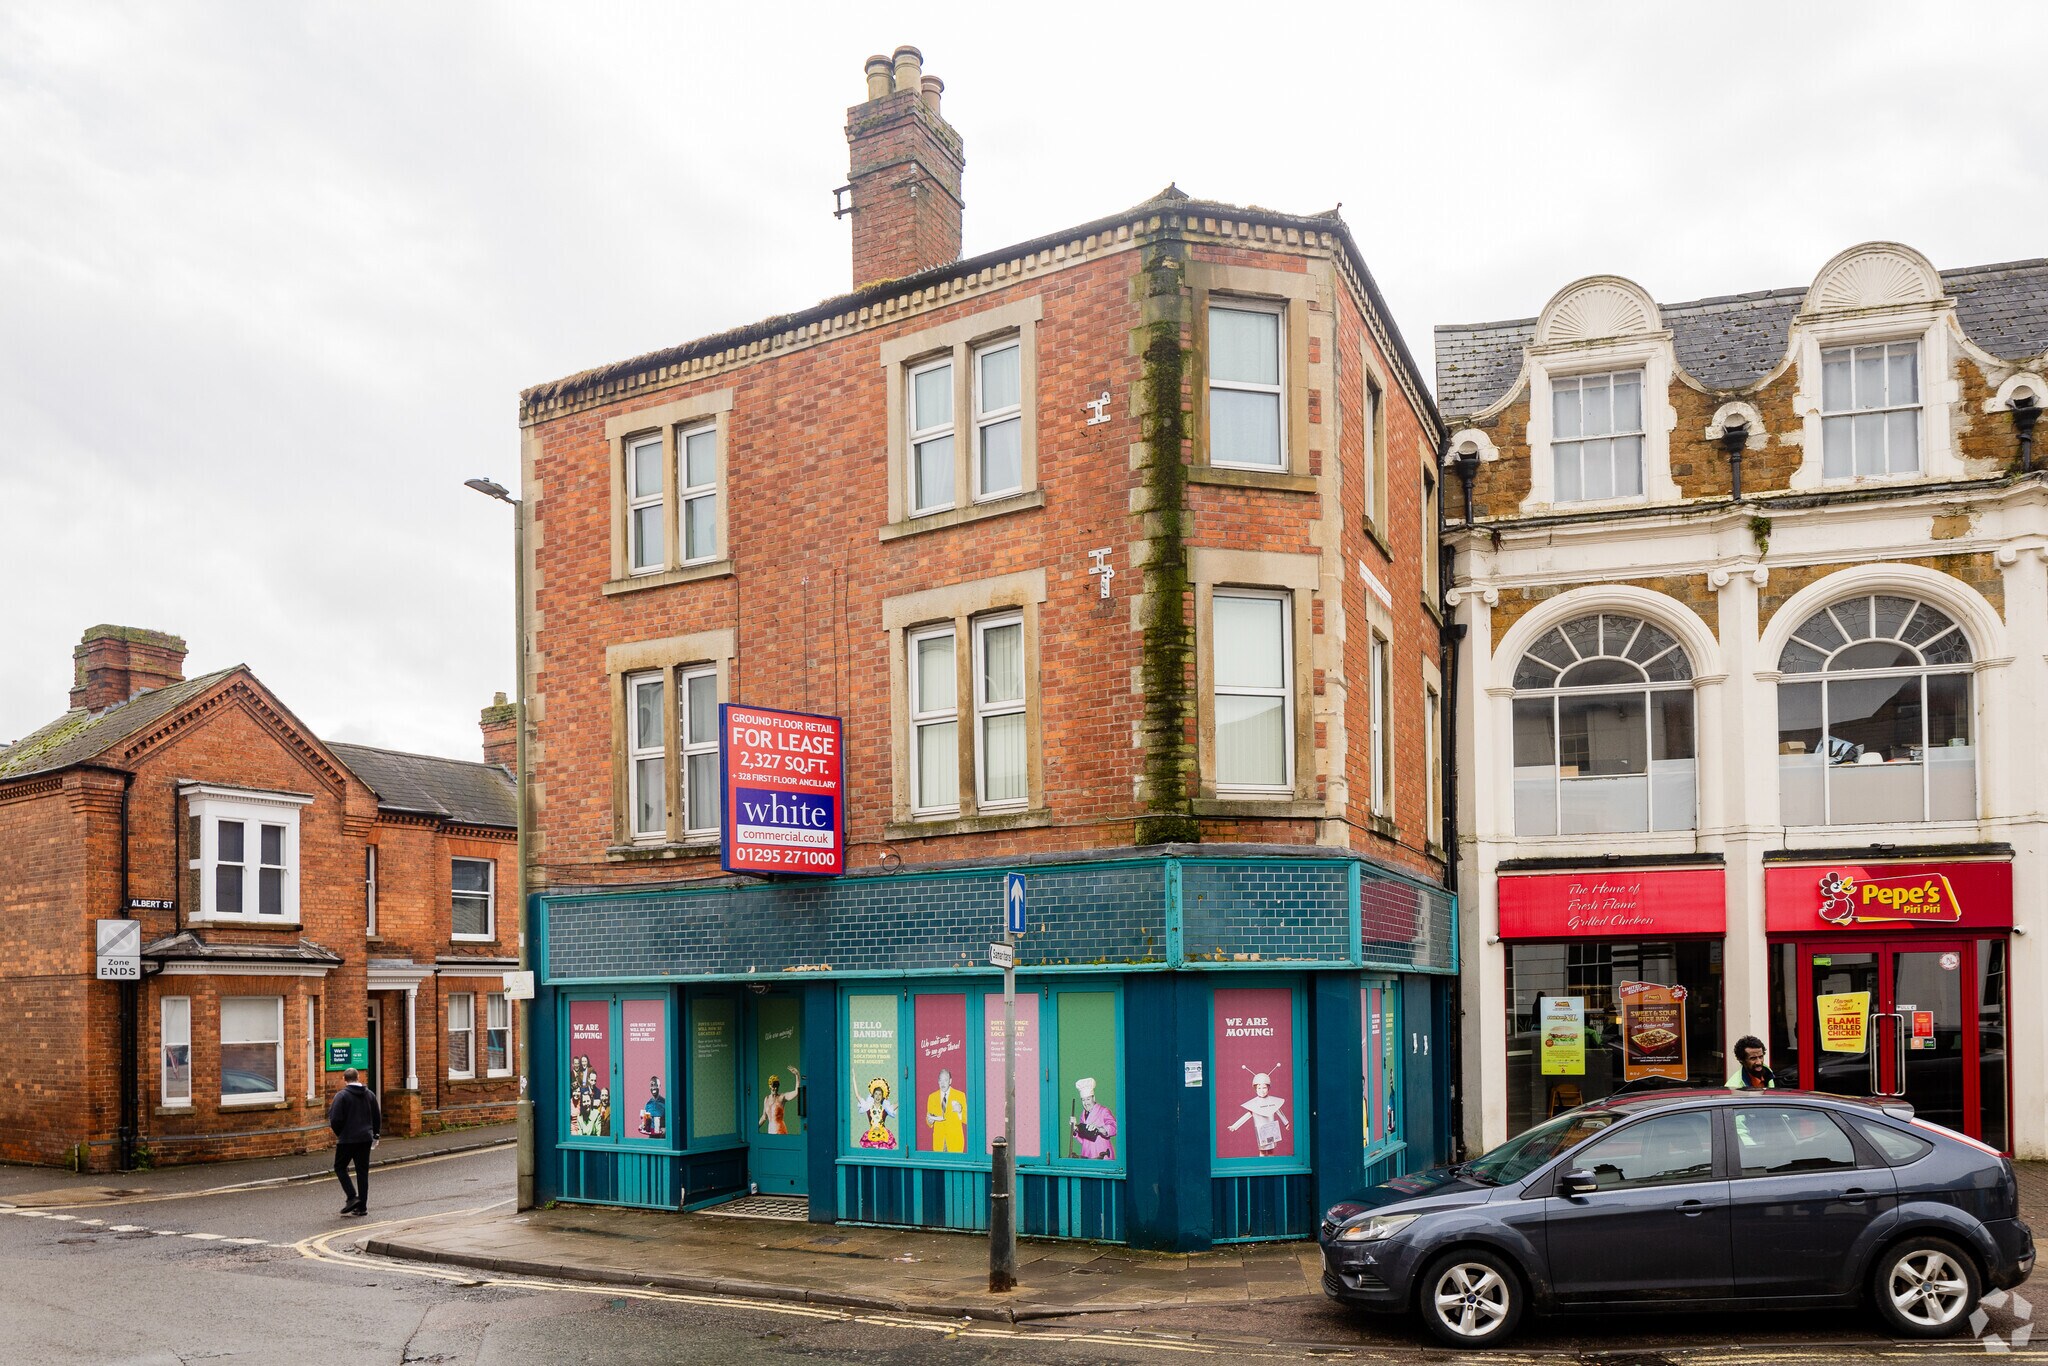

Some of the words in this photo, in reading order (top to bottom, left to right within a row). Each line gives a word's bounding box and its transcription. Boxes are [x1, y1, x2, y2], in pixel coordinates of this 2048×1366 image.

[732, 714, 771, 726] GROUND
[773, 718, 803, 730] FLOOR
[805, 723, 834, 734] RETAIL
[733, 726, 773, 749] FOR
[778, 732, 834, 755] LEASE
[740, 752, 781, 770] 2,327
[738, 772, 751, 781] 328
[752, 774, 772, 783] FIRST
[774, 776, 798, 785] FLOOR
[799, 778, 836, 789] ANCILLARY
[743, 794, 826, 827] white
[743, 829, 828, 844] commercial.co.uk
[736, 848, 780, 863] 01295
[784, 850, 835, 866] 271000
[1568, 883, 1588, 894] The
[1592, 881, 1626, 894] Home
[1628, 883, 1640, 895] of
[1862, 880, 1940, 909] Pepe's
[132, 900, 160, 908] ALBERT
[1568, 898, 1598, 910] Fresh
[1602, 898, 1637, 910] Flame
[1904, 905, 1920, 913] Piri
[1923, 904, 1940, 913] Piri
[1568, 916, 1609, 930] Grilled
[1610, 914, 1654, 926] Chicken
[1622, 984, 1642, 992] LIMITED
[1226, 1018, 1243, 1026] WE
[1246, 1018, 1268, 1026] ARE
[1226, 1028, 1274, 1036] MOVING!
